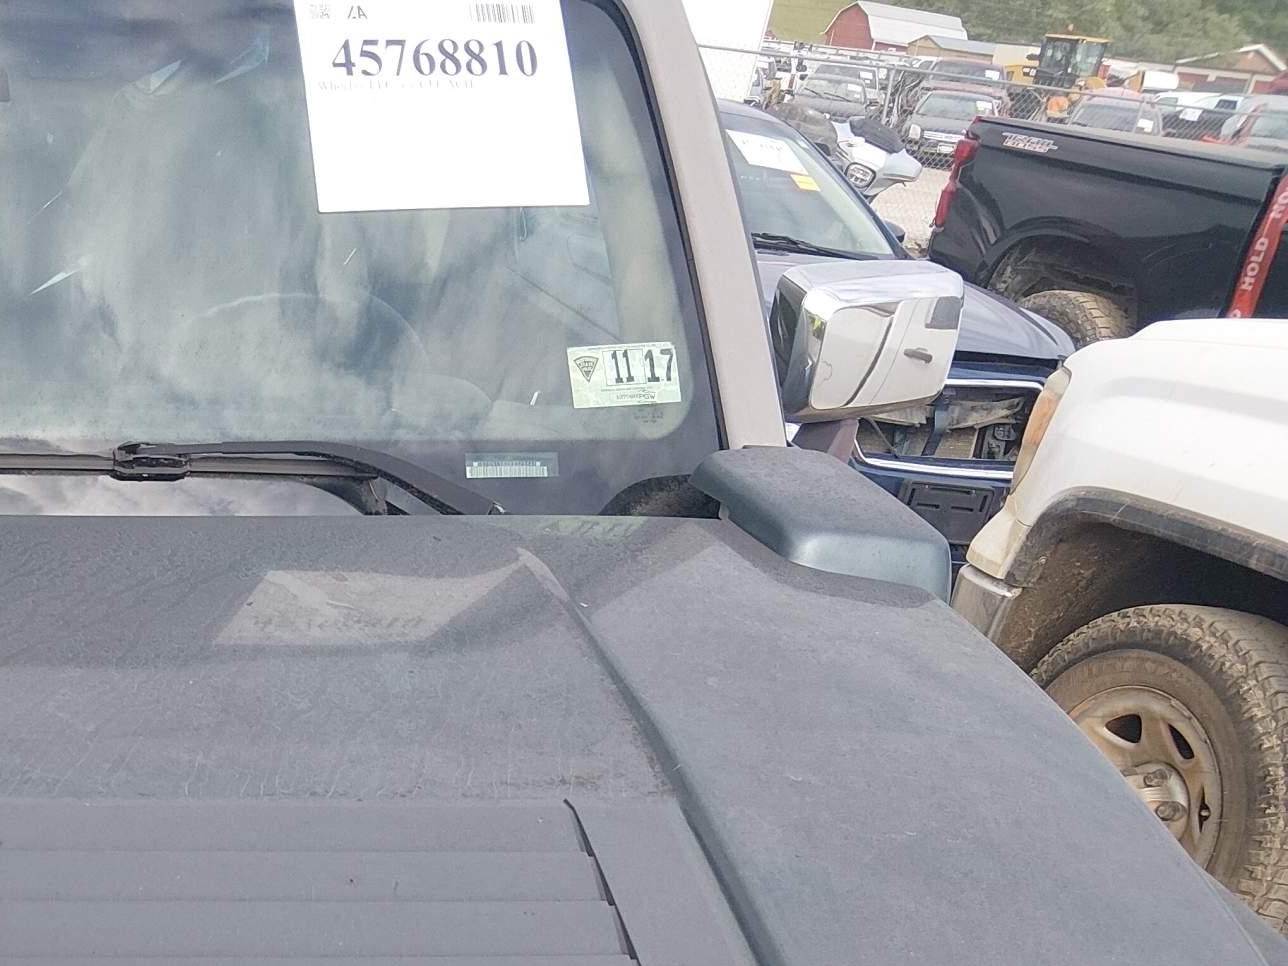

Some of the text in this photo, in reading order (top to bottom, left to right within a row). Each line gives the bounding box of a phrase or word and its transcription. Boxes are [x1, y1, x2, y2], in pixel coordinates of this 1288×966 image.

[332, 38, 538, 77] 45768810
[1240, 237, 1269, 291] HOLD
[611, 349, 635, 384] 11
[644, 348, 674, 383] 17
